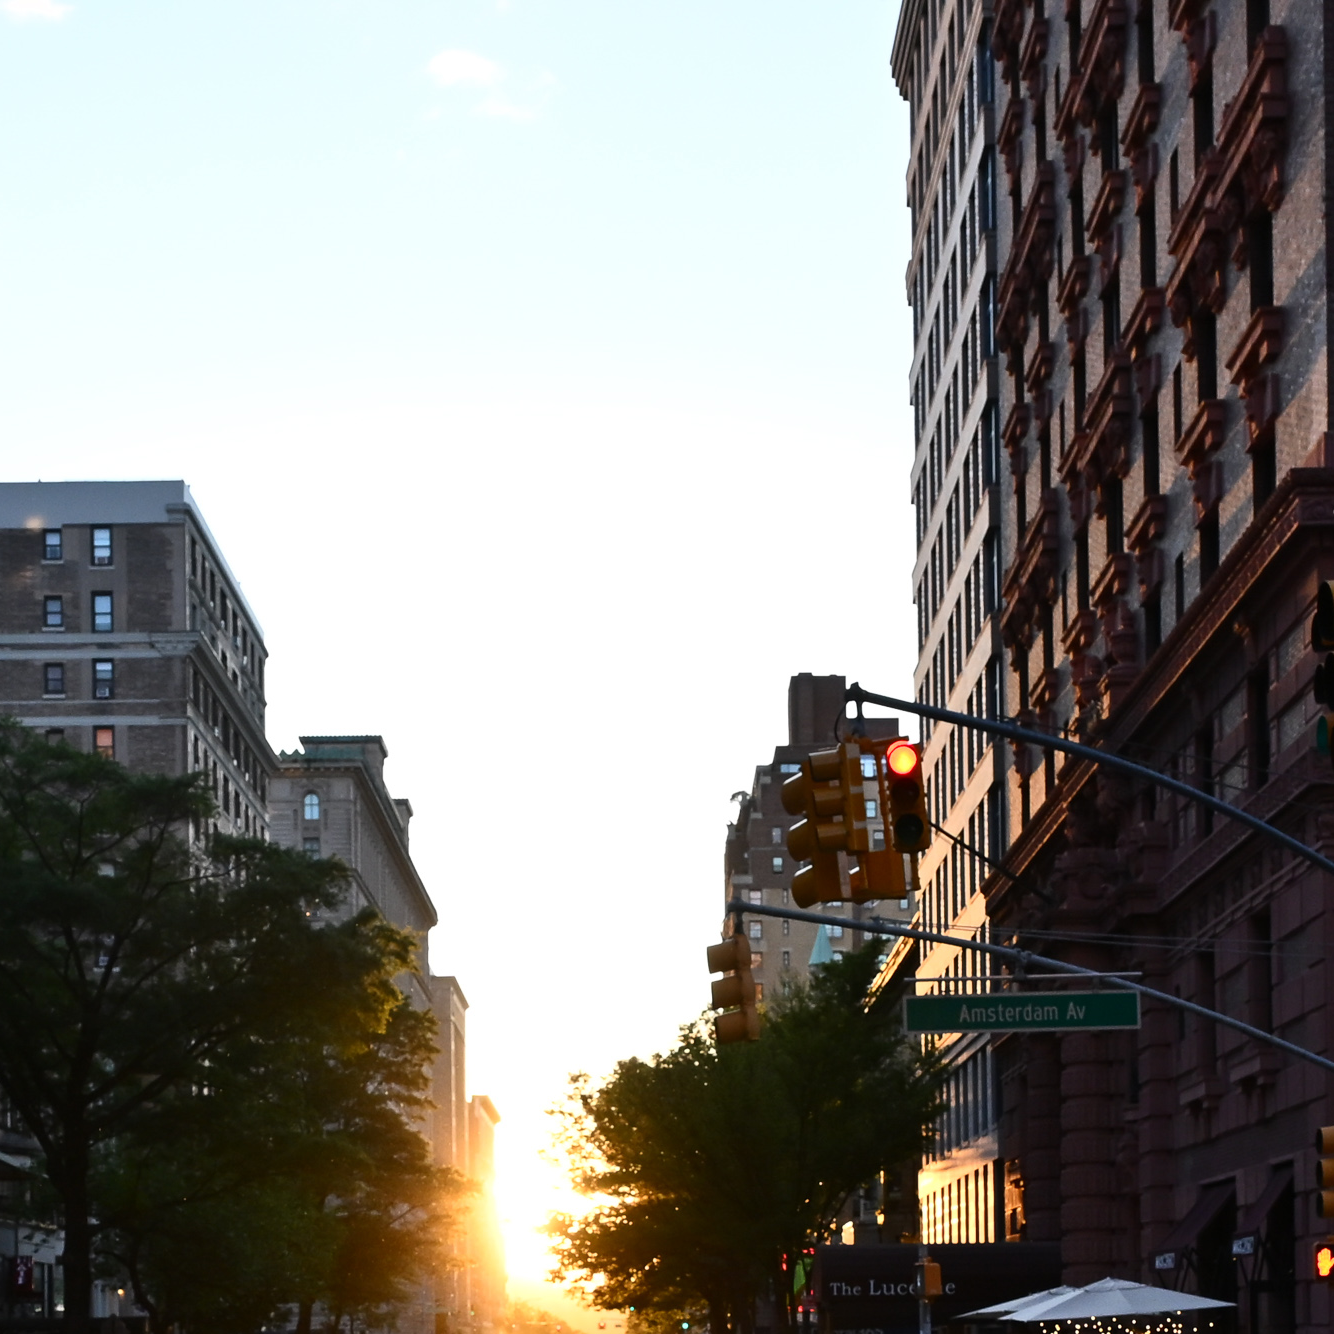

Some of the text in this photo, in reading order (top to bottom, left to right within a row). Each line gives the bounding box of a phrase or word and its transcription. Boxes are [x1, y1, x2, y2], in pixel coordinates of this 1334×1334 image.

[959, 1001, 1086, 1023] Amsterdam Av
[830, 1282, 862, 1296] The
